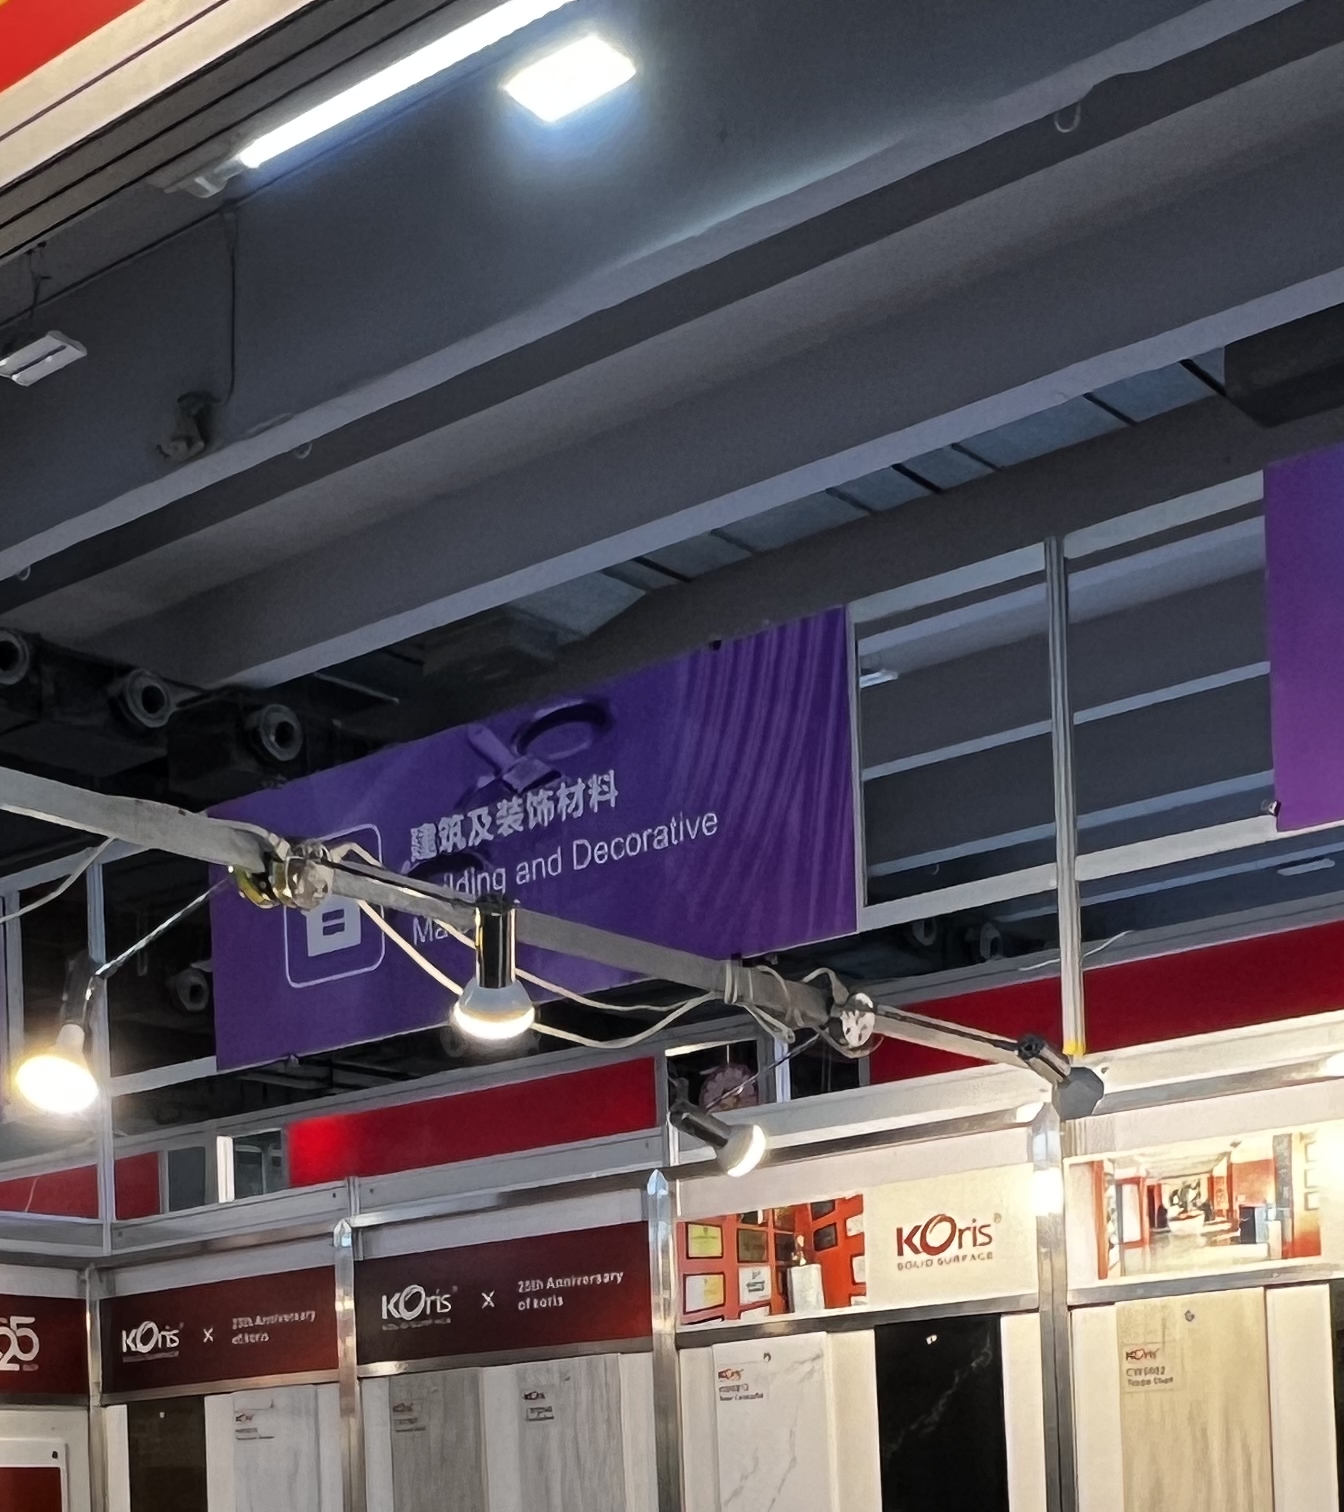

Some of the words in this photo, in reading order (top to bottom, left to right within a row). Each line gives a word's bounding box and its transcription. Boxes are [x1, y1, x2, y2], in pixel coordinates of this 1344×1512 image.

[410, 769, 618, 862] 建筑及装饰材料
[516, 847, 562, 885] and
[573, 812, 718, 871] Decorative
